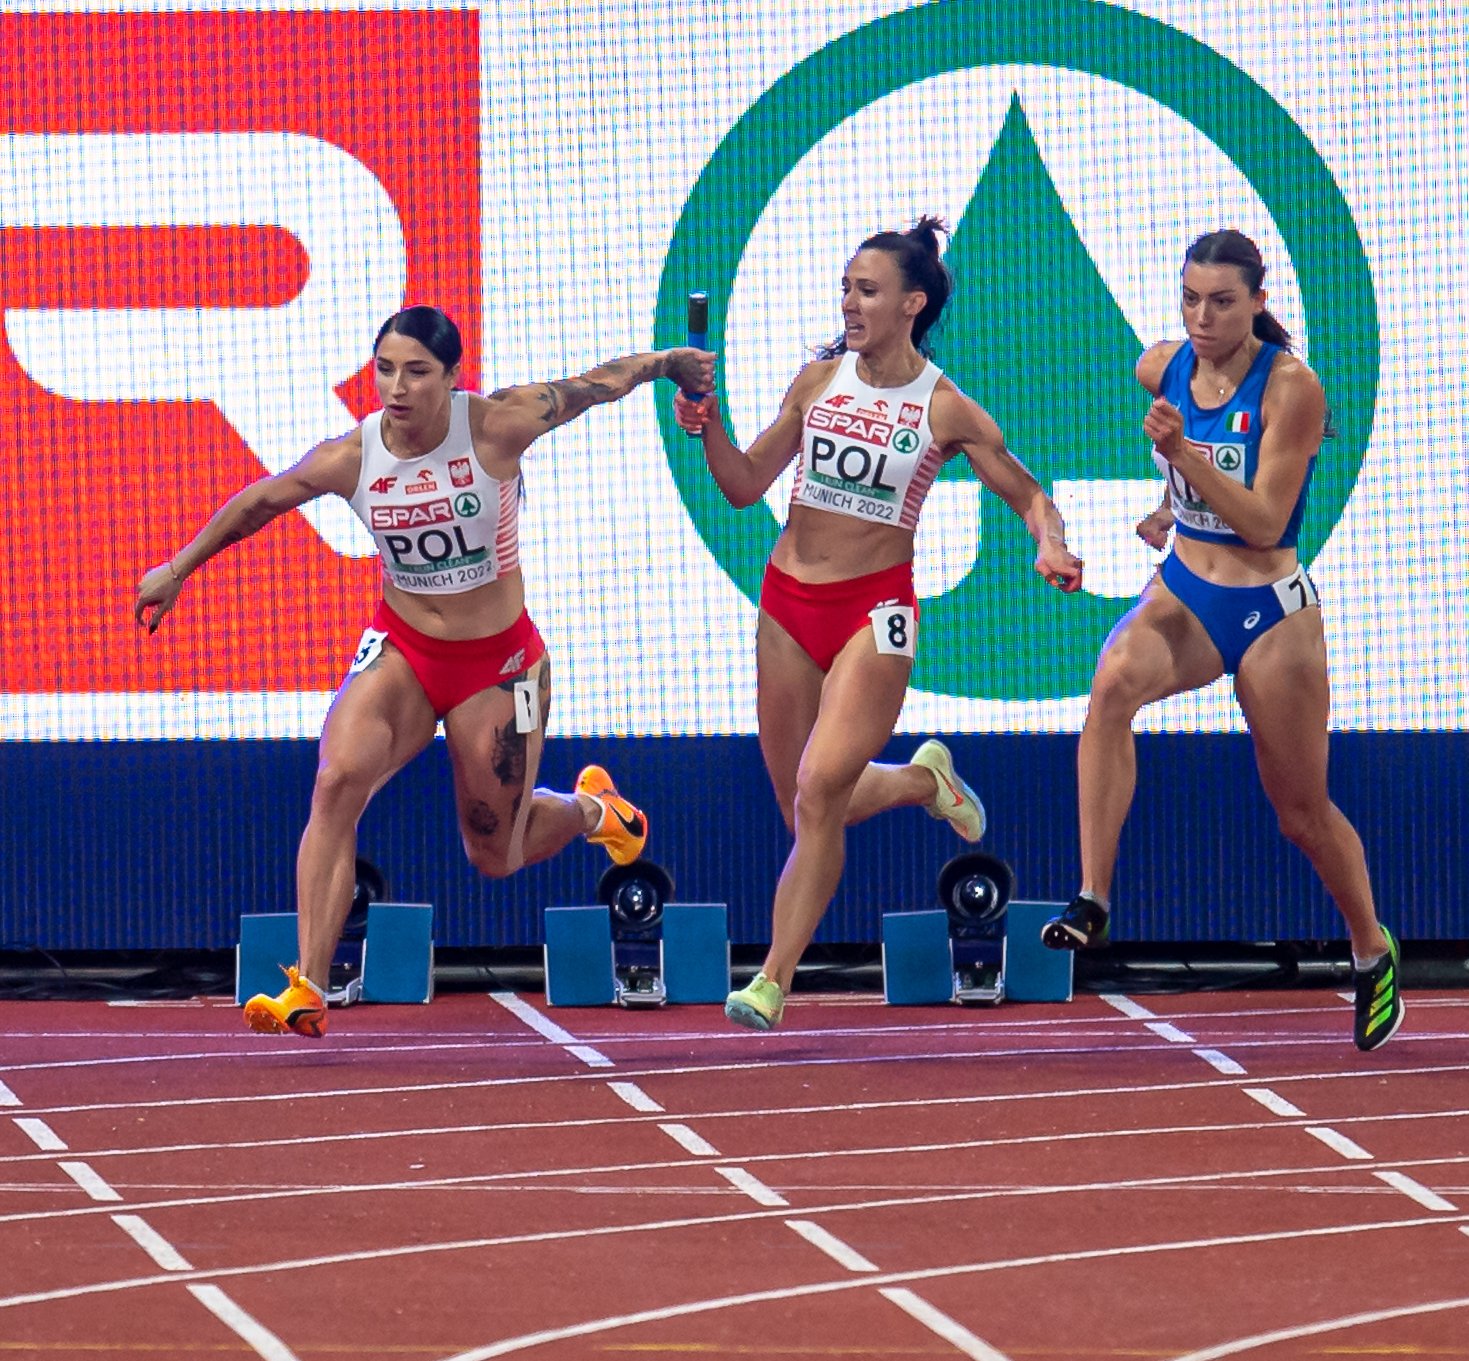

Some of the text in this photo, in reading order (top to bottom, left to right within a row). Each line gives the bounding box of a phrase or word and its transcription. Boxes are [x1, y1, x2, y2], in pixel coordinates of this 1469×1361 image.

[810, 409, 891, 444] SPAR
[811, 436, 896, 493] POL
[369, 476, 398, 494] 4F
[803, 483, 894, 520] MUNICH 2022
[373, 501, 452, 528] SPAR
[384, 525, 486, 564] POL
[396, 560, 492, 588] MUNICH 2022
[1288, 574, 1308, 609] 7
[886, 613, 907, 649] 8
[500, 648, 525, 674] 4F
